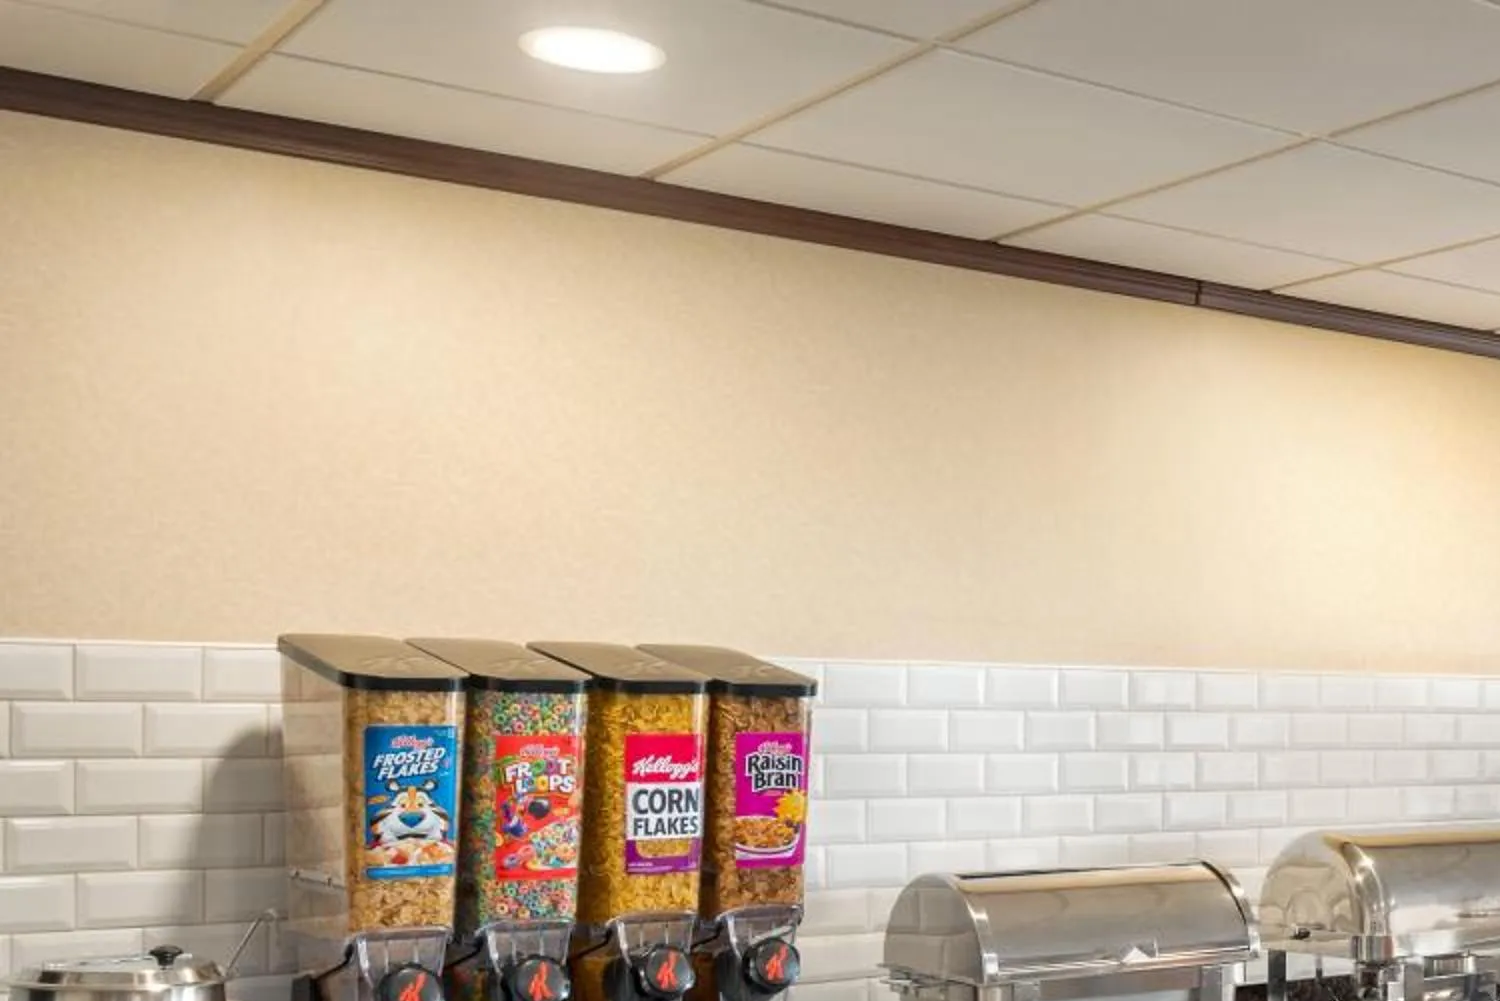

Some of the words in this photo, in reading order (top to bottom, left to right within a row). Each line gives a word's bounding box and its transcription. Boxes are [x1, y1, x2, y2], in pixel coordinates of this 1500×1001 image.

[373, 747, 446, 769] FROSTED
[632, 754, 699, 780] Kellogg's
[747, 754, 803, 774] Raisin
[377, 762, 438, 781] FLAKES
[754, 771, 798, 789] Bran
[632, 787, 699, 815] CORN
[633, 816, 699, 836] FLAKES
